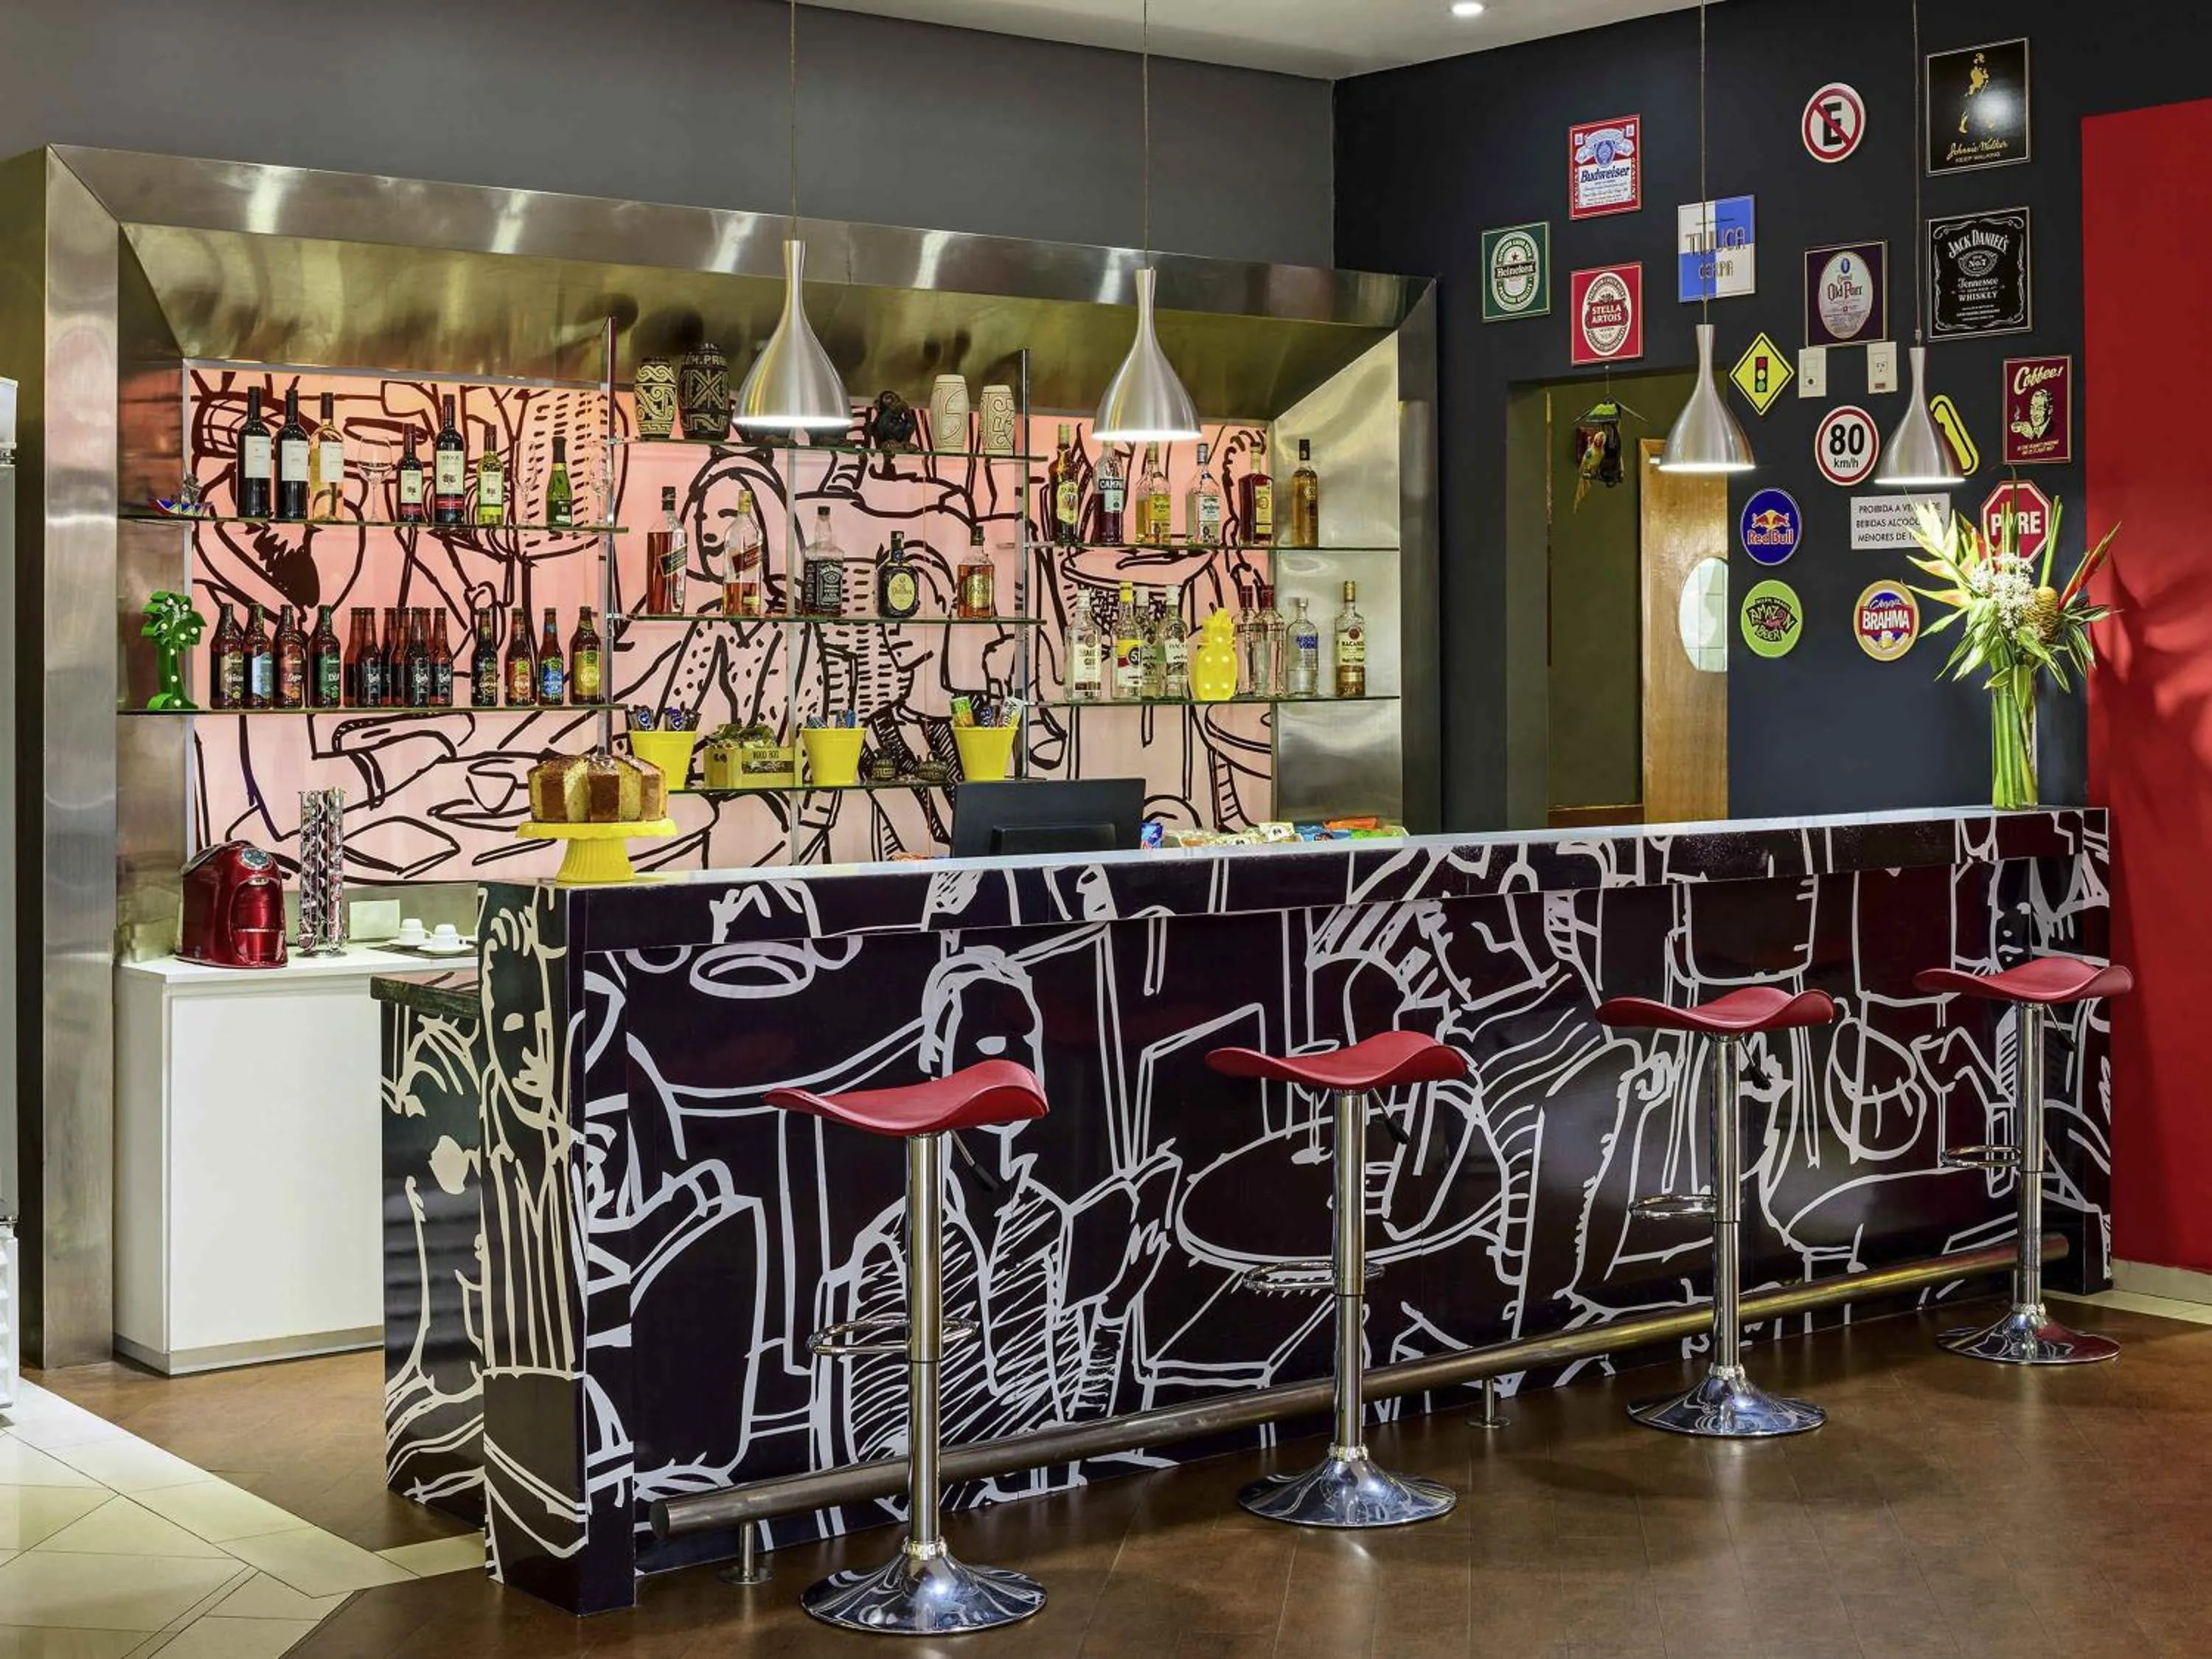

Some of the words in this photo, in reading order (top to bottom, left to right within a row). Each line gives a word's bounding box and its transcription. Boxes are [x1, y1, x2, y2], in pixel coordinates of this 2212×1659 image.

[1947, 142, 1978, 161] Johnnie
[1580, 165, 1630, 183] Budweiser
[1947, 234, 1972, 259] JACK
[1972, 229, 2010, 254] DANIEL'S
[1496, 262, 1534, 277] Heineken
[1958, 277, 1999, 288] Tennessee
[1958, 291, 1997, 302] WHISKEY
[1592, 304, 1622, 316] STELLA
[1591, 313, 1622, 324] ARTOIS
[1829, 422, 1865, 456] 80
[1834, 456, 1859, 468] km/h
[1894, 504, 1900, 512] A
[1856, 518, 1887, 529] BEBIDAS
[1991, 511, 2042, 536] PRE
[1747, 529, 1770, 545] Red
[1770, 528, 1794, 545] Bull
[1858, 532, 1894, 543] MENORES
[1896, 532, 1906, 540] DE
[1748, 604, 1796, 630] AMAZON
[1862, 610, 1910, 630] BRAHMA
[1756, 625, 1781, 641] BEER
